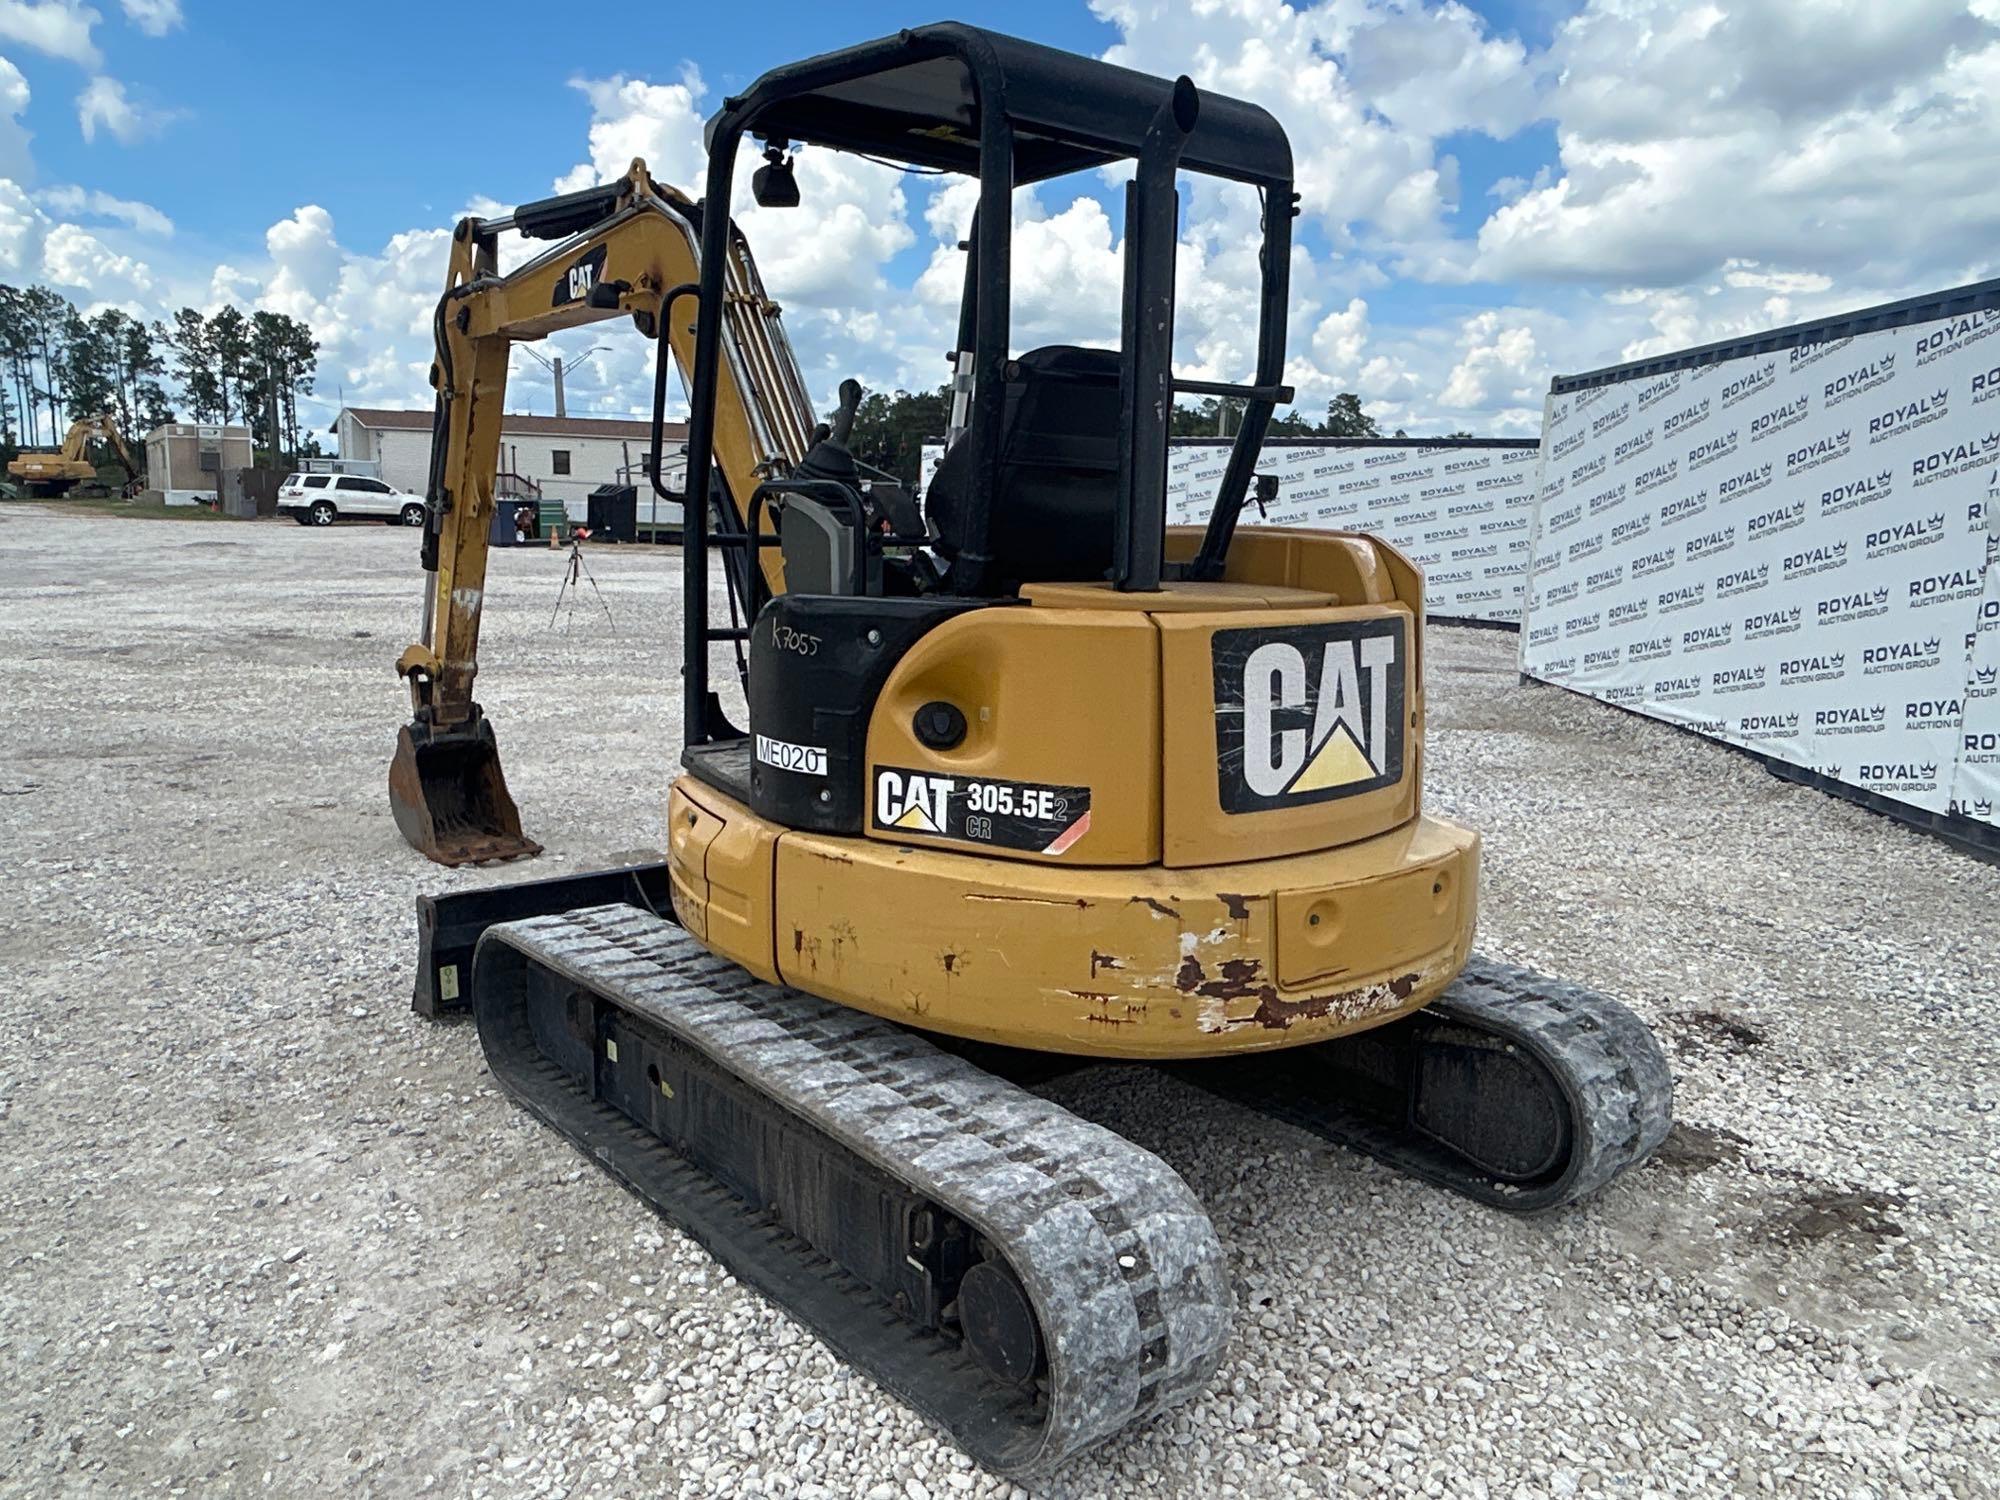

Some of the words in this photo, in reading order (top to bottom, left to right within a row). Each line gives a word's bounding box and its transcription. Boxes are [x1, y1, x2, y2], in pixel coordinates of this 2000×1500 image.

[569, 263, 593, 299] CAT
[1916, 314, 1983, 356] ROYAL
[1916, 341, 1963, 367] AUCTION
[1963, 322, 2000, 346] GROUP
[1722, 370, 1763, 401] ROYAL
[1824, 362, 1879, 398] ROYAL
[1824, 388, 1863, 409] AUCTION
[1863, 371, 1896, 392] GROUP
[1638, 379, 1671, 404] ROYAL
[1664, 404, 1700, 431] ROYAL
[1751, 403, 1795, 433] ROYAL
[1869, 399, 1930, 434] ROYAL
[1870, 423, 1911, 445] AUCTION
[1911, 408, 1948, 429] GROUP
[1614, 433, 1645, 458] ROYAL
[1688, 437, 1727, 463] ROYAL
[1787, 436, 1836, 467] ROYAL
[1364, 453, 1397, 465] ROYAL
[1444, 459, 1480, 471] ROYAL
[1913, 441, 1980, 475] ROYAL
[1313, 464, 1345, 475] ROYAL
[1390, 469, 1424, 481] ROYAL
[1635, 464, 1668, 487] ROYAL
[1913, 466, 1959, 488] AUCTION
[1959, 452, 2000, 472] GROUP
[1338, 480, 1371, 490] ROYAL
[1476, 475, 1513, 487] ROYAL
[1720, 469, 1761, 496] ROYAL
[1290, 489, 1322, 499] ROYAL
[1367, 496, 1401, 507] ROYAL
[1420, 486, 1455, 497] ROYAL
[1821, 477, 1876, 507] ROYAL
[1317, 505, 1349, 515] ROYAL
[1448, 503, 1483, 514] ROYAL
[1661, 495, 1697, 518] ROYAL
[1821, 499, 1859, 517] AUCTION
[1859, 488, 1892, 506] GROUP
[1393, 512, 1428, 523] ROYAL
[1480, 520, 1516, 531] ROYAL
[1748, 506, 1792, 532] ROYAL
[1424, 529, 1459, 540] ROYAL
[1611, 519, 1642, 539] ROYAL
[1866, 519, 1927, 549] ROYAL
[1451, 547, 1487, 557] ROYAL
[1686, 530, 1724, 554] ROYAL
[1866, 541, 1908, 560] AUCTION
[1908, 532, 1945, 549] GROUP
[1631, 551, 1666, 571] ROYAL
[1783, 546, 1833, 571] ROYAL
[1428, 573, 1462, 582] ROYAL
[1483, 564, 1518, 574] ROYAL
[1586, 569, 1614, 587] ROYAL
[1717, 569, 1757, 590] ROYAL
[1910, 570, 1977, 597] ROYAL
[1456, 590, 1490, 600] ROYAL
[1658, 587, 1695, 606] ROYAL
[1956, 587, 1983, 600] GRO
[1608, 602, 1639, 620] ROYAL
[1818, 593, 1873, 616] ROYAL
[1566, 615, 1593, 631] ROYAL
[1745, 610, 1788, 631] ROYAL
[1818, 611, 1856, 626] AUCTION
[1856, 606, 1889, 620] GROUP
[1683, 627, 1721, 644] ROYAL
[1584, 649, 1613, 665] ROYAL
[1629, 640, 1662, 655] ROYAL
[1863, 642, 1923, 663] ROYAL
[1780, 656, 1830, 675] ROYAL
[1863, 660, 1904, 675] AUCTION
[1905, 657, 1941, 671] GROUP
[1654, 678, 1691, 693] ROYAL
[1713, 667, 1753, 685] ROYAL
[1606, 687, 1635, 700] ROYAL
[1244, 635, 1394, 796] CAT
[1815, 709, 1870, 725] ROYAL
[1905, 700, 1961, 719] ROYA
[1740, 715, 1785, 730] ROYAL
[1906, 719, 1952, 730] AUCTION
[759, 737, 819, 772] ME020
[1860, 765, 1919, 780] ROYAL
[877, 771, 955, 834] CAT
[966, 815, 992, 840] CR
